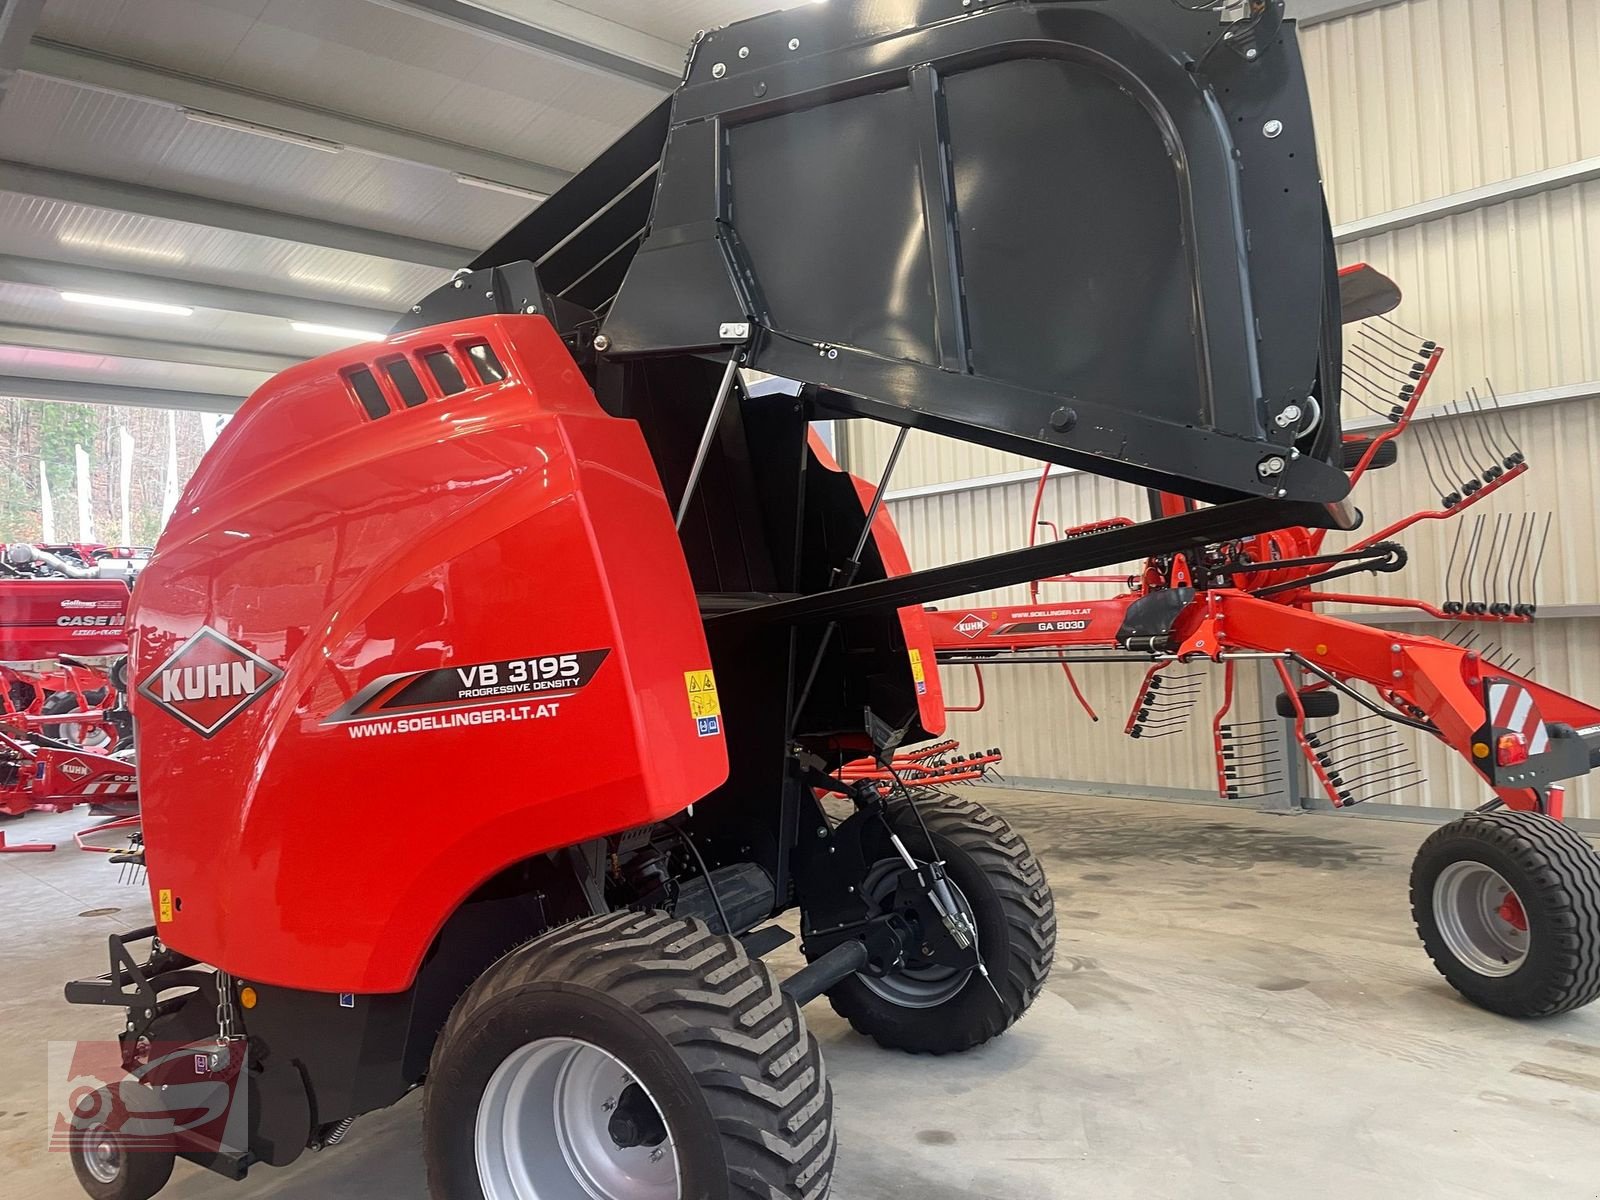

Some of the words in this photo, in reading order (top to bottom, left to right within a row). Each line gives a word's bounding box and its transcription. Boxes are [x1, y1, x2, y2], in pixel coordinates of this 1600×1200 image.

[56, 615, 109, 626] CASE
[959, 621, 984, 632] KUHN
[1037, 622, 1054, 631] GA
[1056, 620, 1085, 630] 8030
[456, 664, 498, 688] VB
[508, 654, 580, 683] 3195
[162, 660, 255, 702] KUHN
[458, 683, 531, 699] PROGRESSIVE
[533, 677, 581, 691] DENSITY
[348, 703, 560, 739] WWW.SOELLINGER-LT.AT
[62, 764, 88, 775] KUHN
